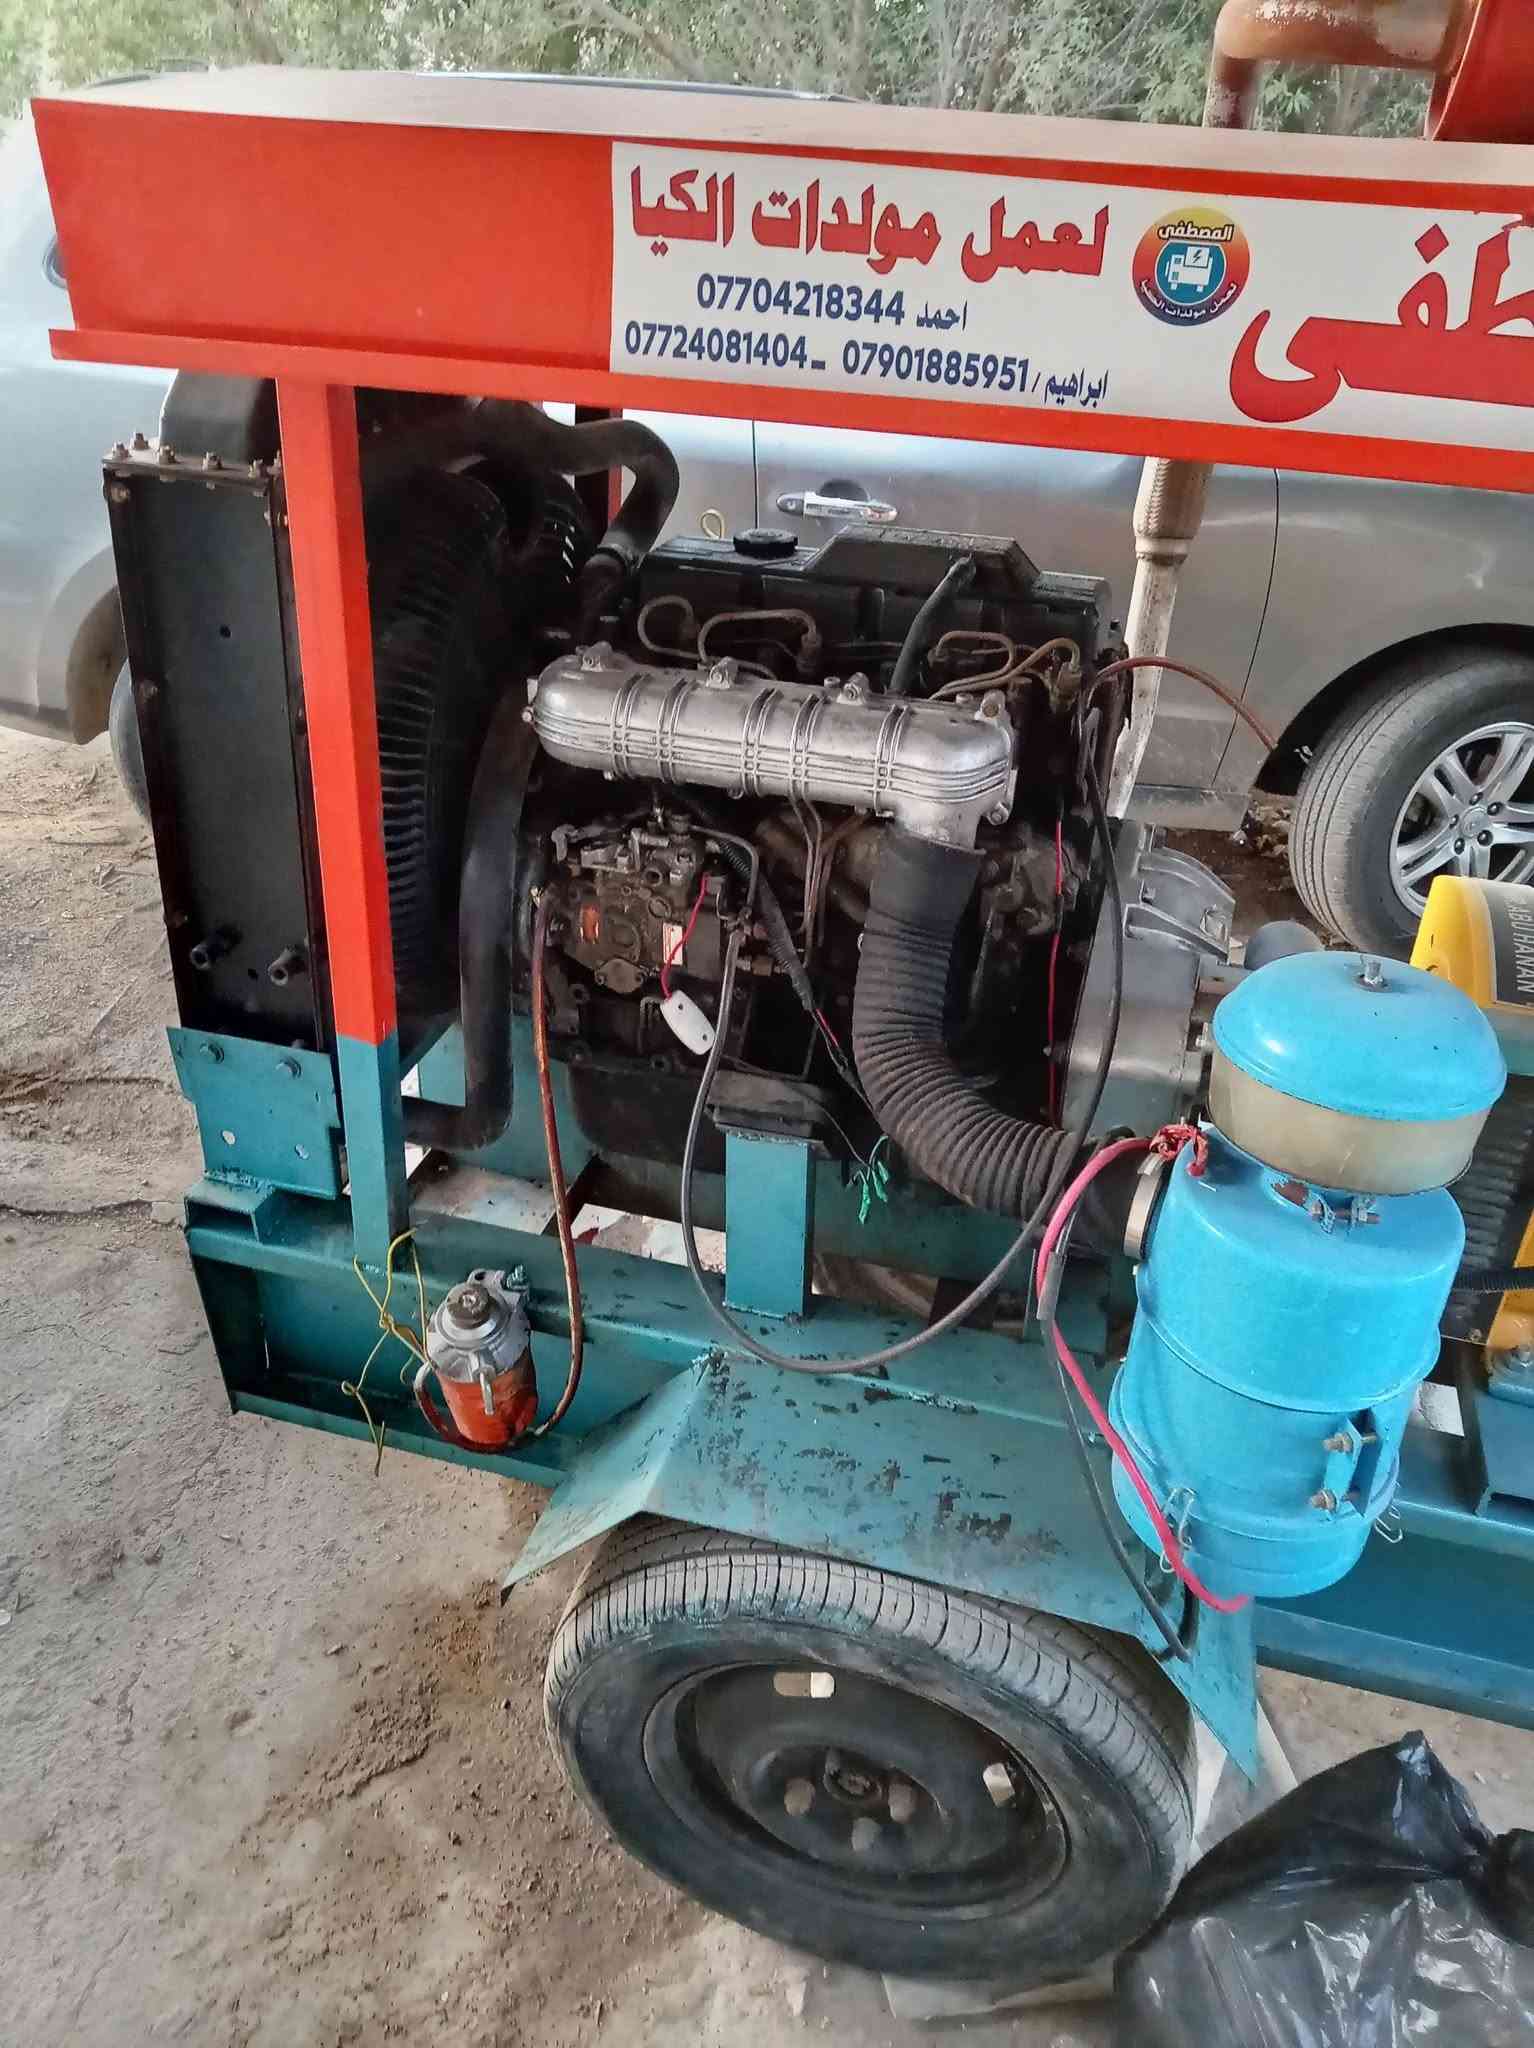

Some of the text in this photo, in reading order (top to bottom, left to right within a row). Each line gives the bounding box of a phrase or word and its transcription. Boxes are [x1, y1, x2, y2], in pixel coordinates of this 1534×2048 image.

[630, 165, 1109, 283] لعمل مولدات الكيا
[697, 273, 968, 331] احمد 07704218344
